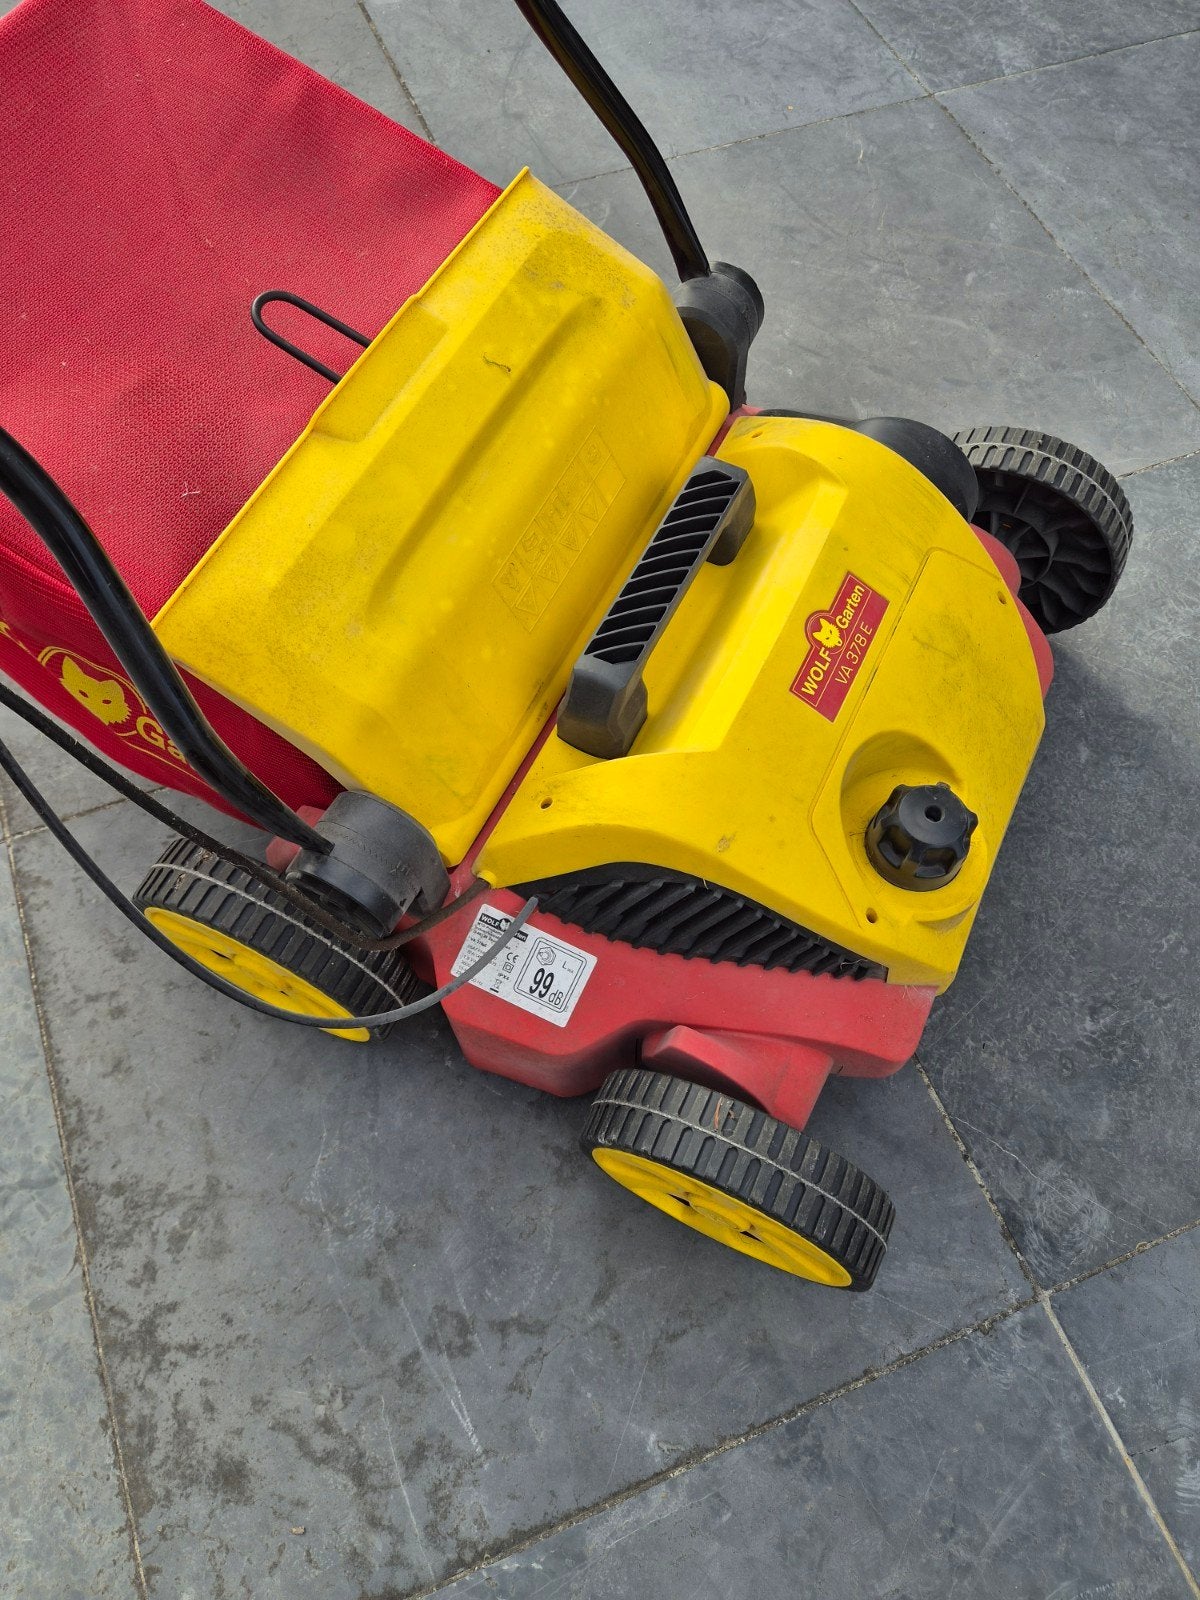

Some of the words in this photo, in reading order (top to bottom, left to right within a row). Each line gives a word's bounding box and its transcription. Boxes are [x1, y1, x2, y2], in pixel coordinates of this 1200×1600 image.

[801, 646, 832, 696] WOLF
[835, 585, 865, 629] Garten
[834, 665, 853, 684] VA
[846, 633, 867, 664] 378
[860, 621, 873, 635] E
[481, 914, 500, 929] WOLF
[529, 968, 554, 998] 99
[548, 989, 564, 1005] dB
